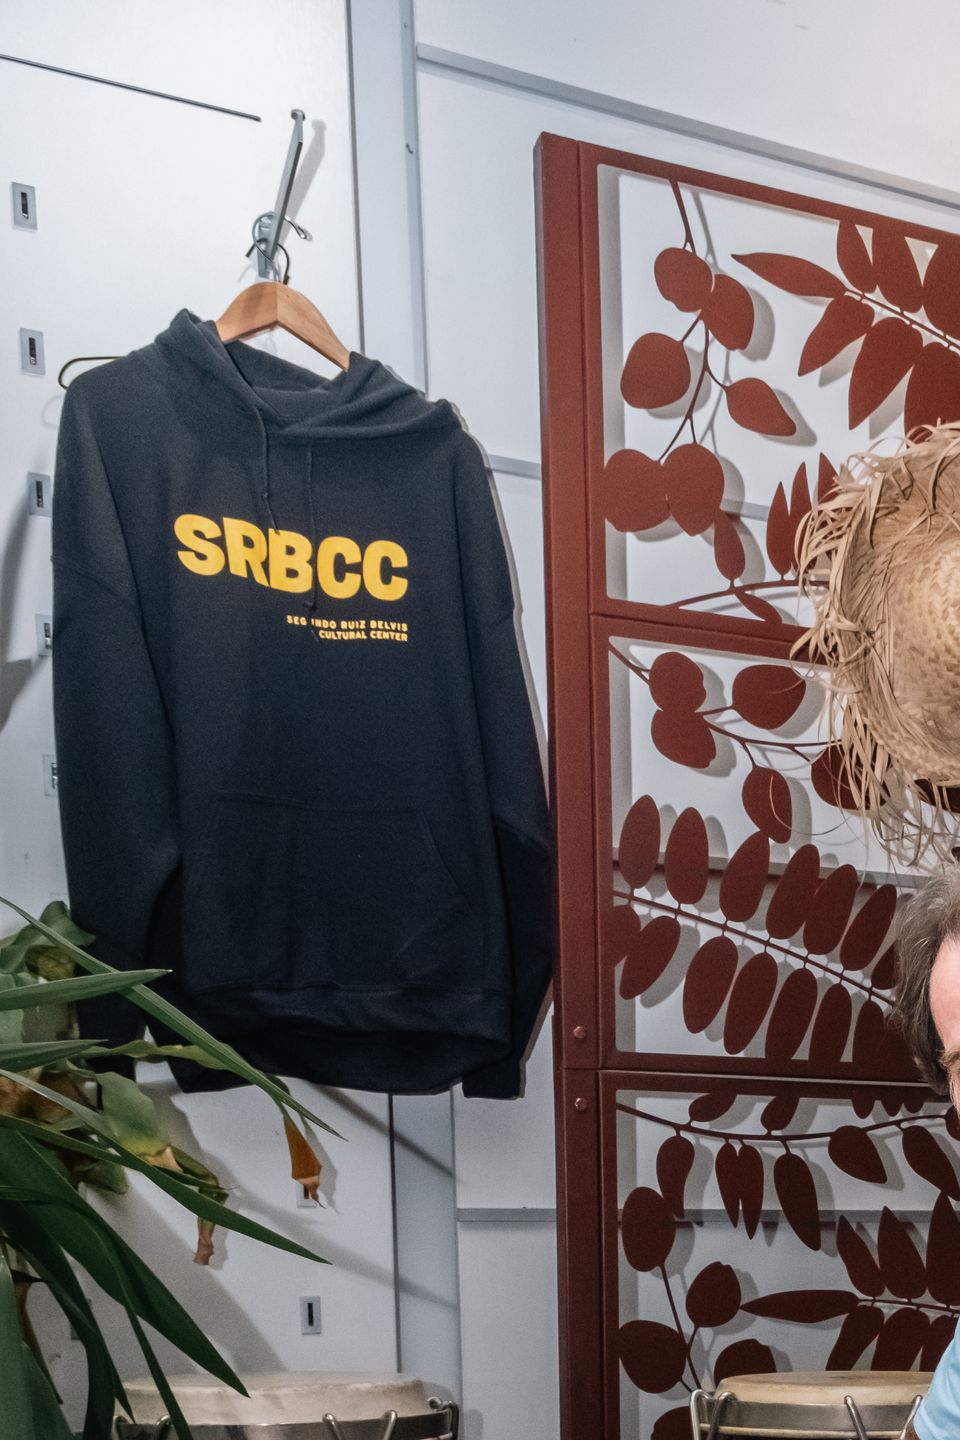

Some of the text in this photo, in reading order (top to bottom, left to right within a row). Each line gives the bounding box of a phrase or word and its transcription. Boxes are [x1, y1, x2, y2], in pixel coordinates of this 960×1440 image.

[173, 513, 409, 601] SRBCC
[340, 620, 365, 631] RUIZ
[369, 620, 408, 632] BELVIS
[318, 630, 408, 642] CULTURAL CENTER
